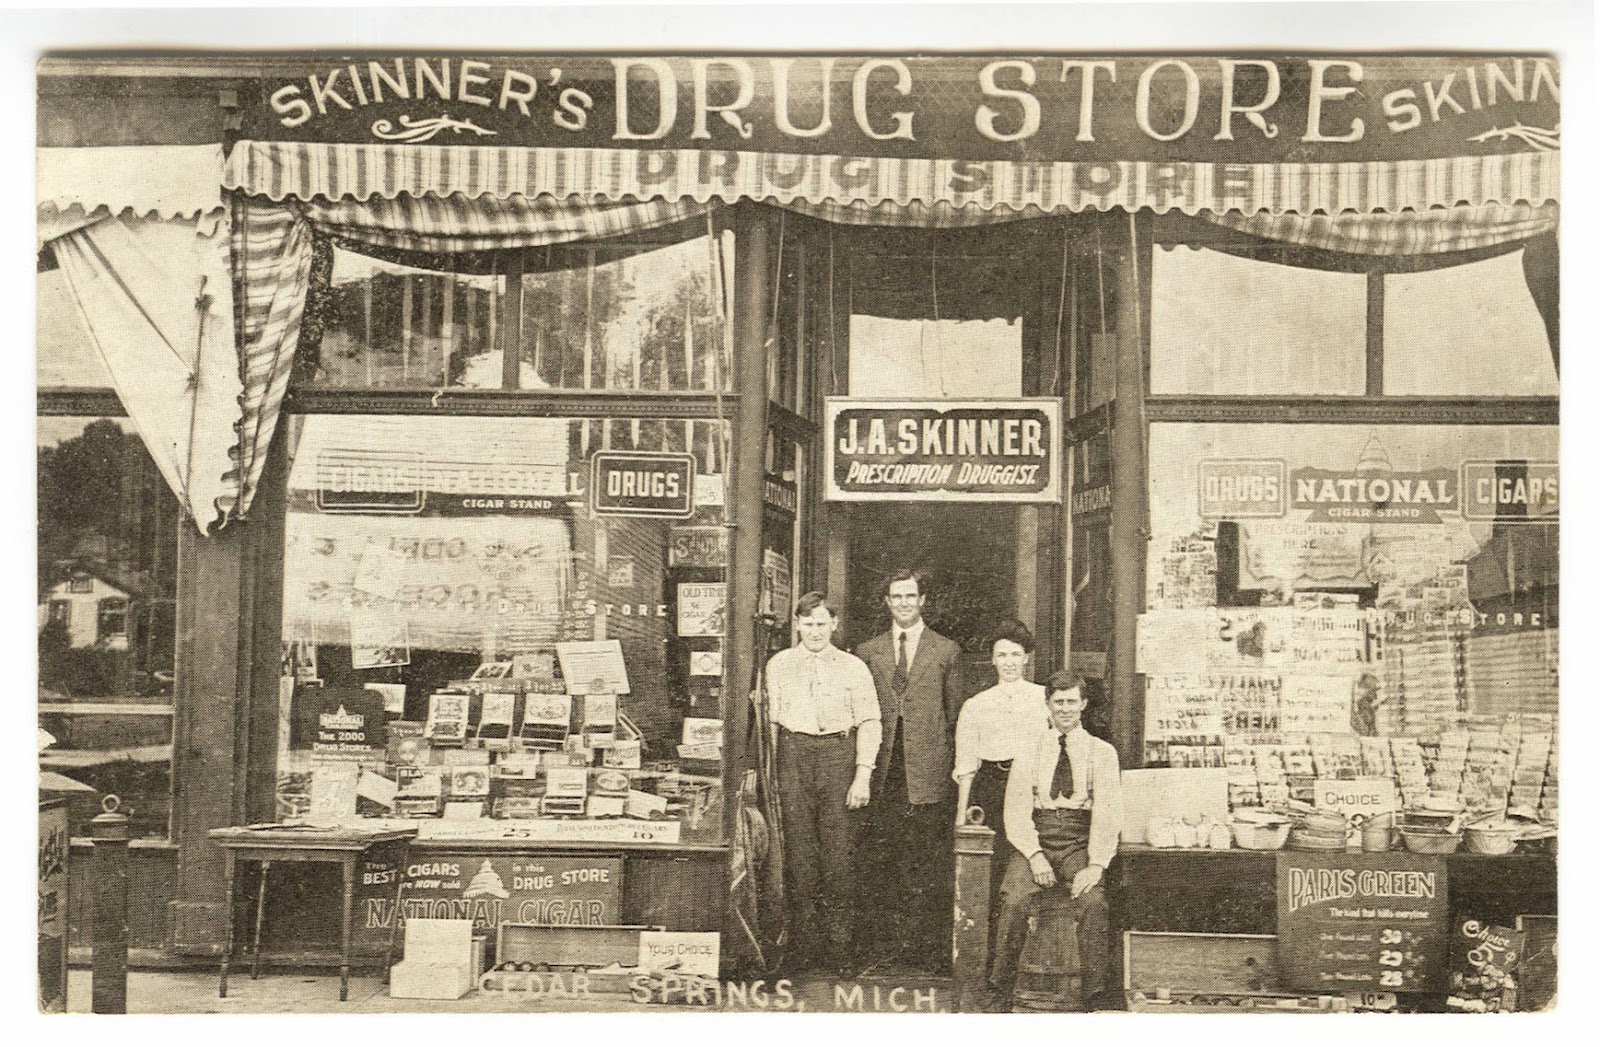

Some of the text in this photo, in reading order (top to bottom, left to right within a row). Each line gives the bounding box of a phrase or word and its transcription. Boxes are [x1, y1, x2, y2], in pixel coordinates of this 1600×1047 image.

[269, 57, 593, 130] SKINNER'S
[611, 56, 915, 142] DRUG
[974, 58, 1365, 143] STORE
[636, 149, 872, 187] DRUG
[844, 460, 954, 485] PRESCRIPTION
[606, 470, 681, 499] DRUGS
[1203, 475, 1279, 502] DRUGS
[1296, 479, 1454, 504] NATIONAL
[1476, 477, 1557, 505] CIGARS
[462, 498, 552, 510] CIGAR STAND
[1328, 507, 1420, 519] CIGAR STAND
[585, 599, 668, 617] STORE
[1459, 607, 1541, 626] STORE
[337, 731, 366, 742] 2000
[1325, 792, 1381, 806] CHOICE
[362, 862, 460, 885] BEST CIGARS
[414, 879, 441, 889] NOW
[513, 868, 610, 890] DRUG STORE
[1289, 868, 1435, 912] PARIS GREEN
